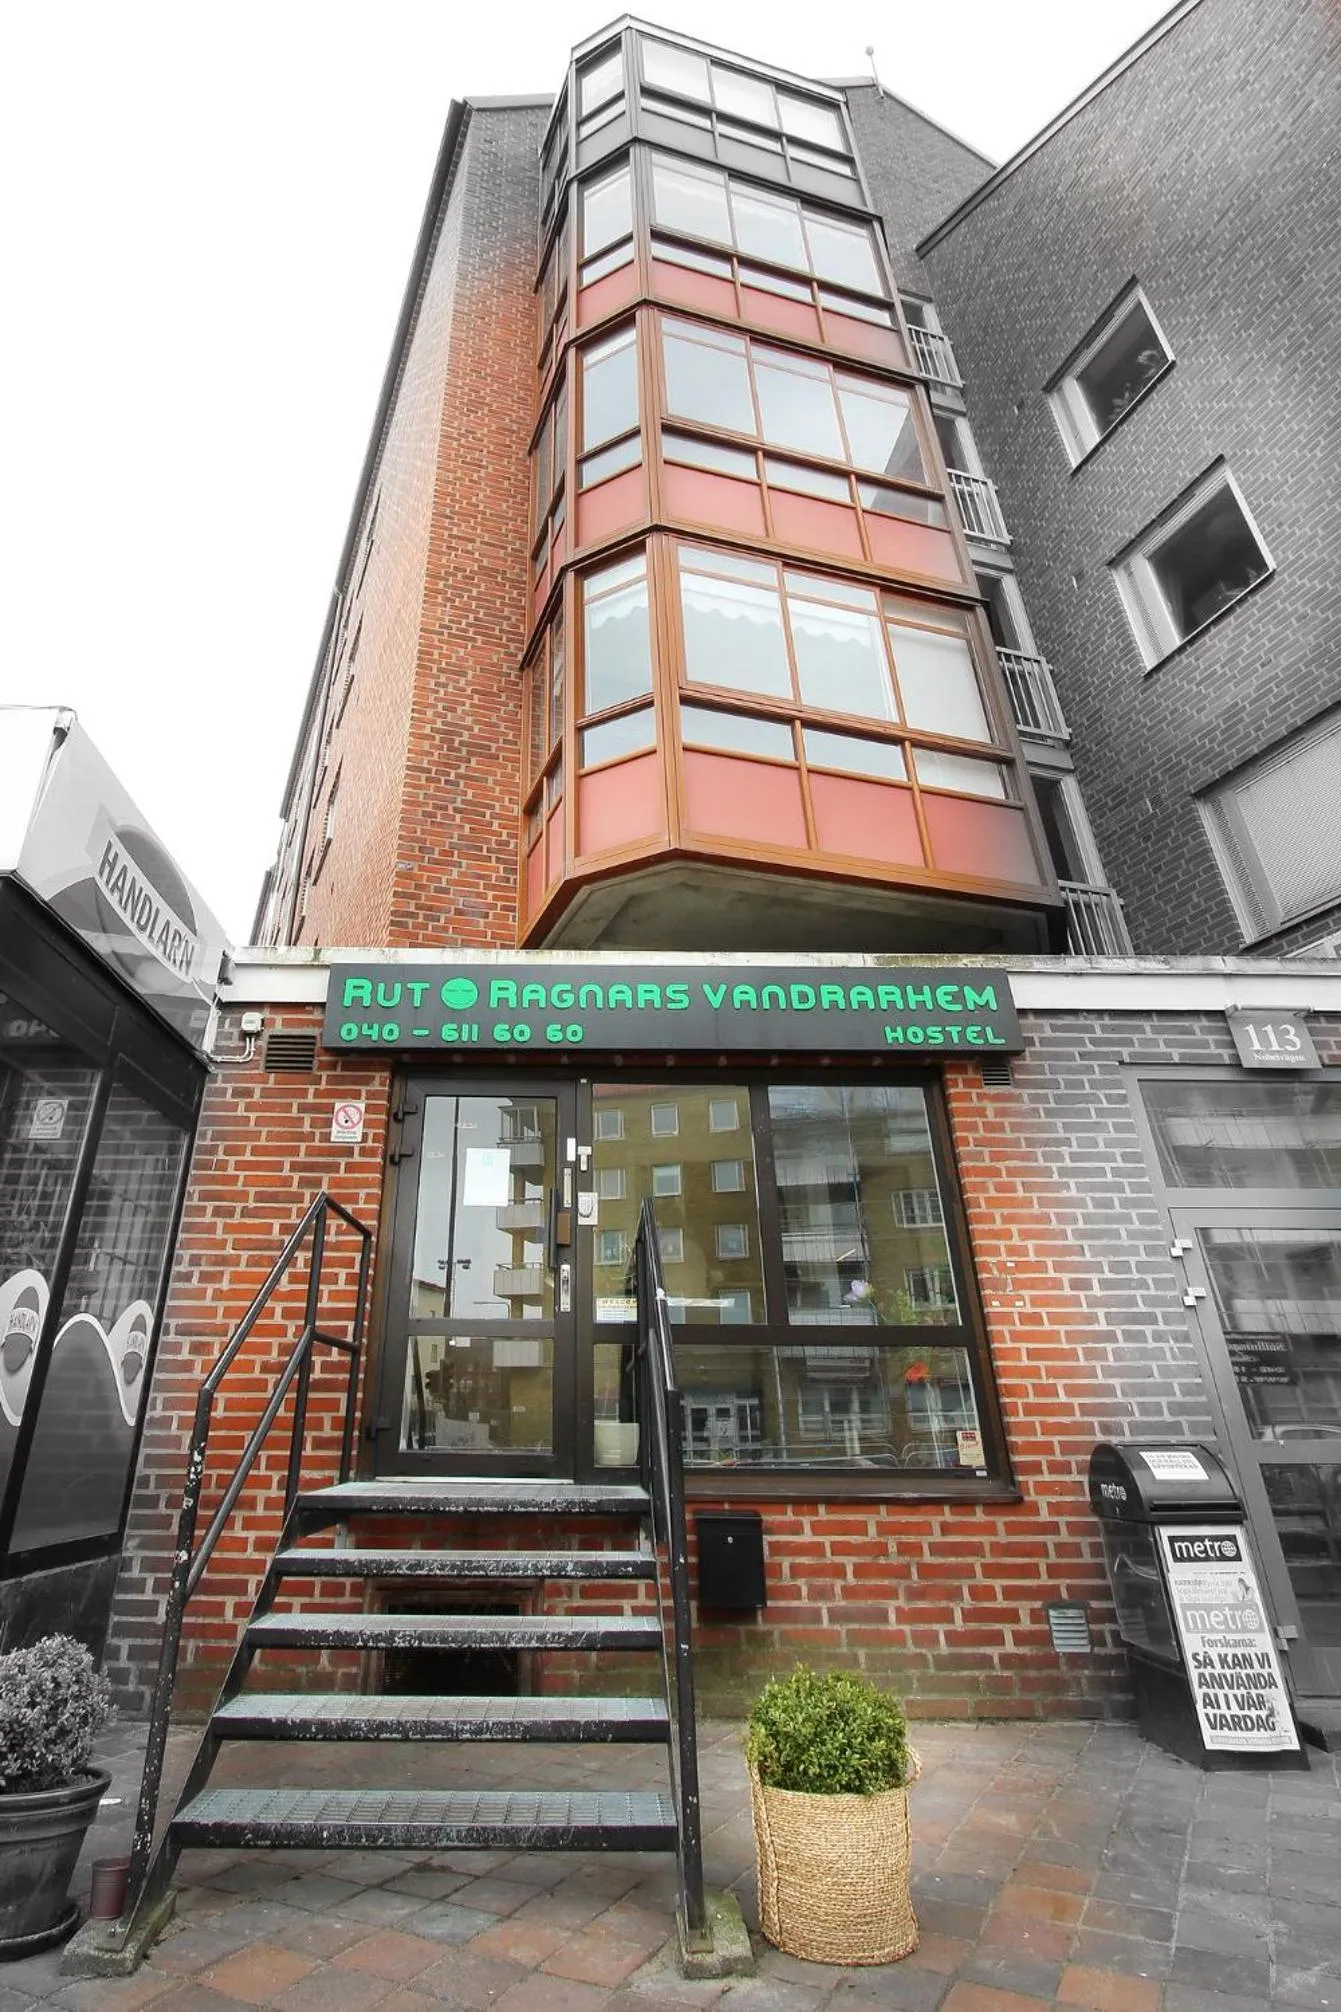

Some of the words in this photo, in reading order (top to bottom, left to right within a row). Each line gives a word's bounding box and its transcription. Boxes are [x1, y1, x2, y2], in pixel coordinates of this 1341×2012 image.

[341, 978, 430, 1008] RUT
[488, 979, 691, 1010] RAGNARS
[701, 982, 999, 1012] VANDRARHEM
[339, 1022, 400, 1042] 040
[440, 1022, 479, 1043] 611
[493, 1022, 531, 1043] 60
[545, 1022, 584, 1043] 60
[883, 1024, 1007, 1046] HOSTEL
[1242, 1024, 1301, 1051] 113
[1174, 1537, 1238, 1558] metro
[1185, 1606, 1260, 1630] metro
[1191, 1651, 1216, 1669] SÅ
[1217, 1652, 1255, 1670] KAN
[1255, 1652, 1272, 1669] VI
[1197, 1671, 1279, 1690] ANVÄNDA
[1202, 1692, 1221, 1710] AI
[1222, 1693, 1232, 1710] I
[1232, 1691, 1267, 1710] VÅR
[1203, 1712, 1276, 1732] VARDAG
